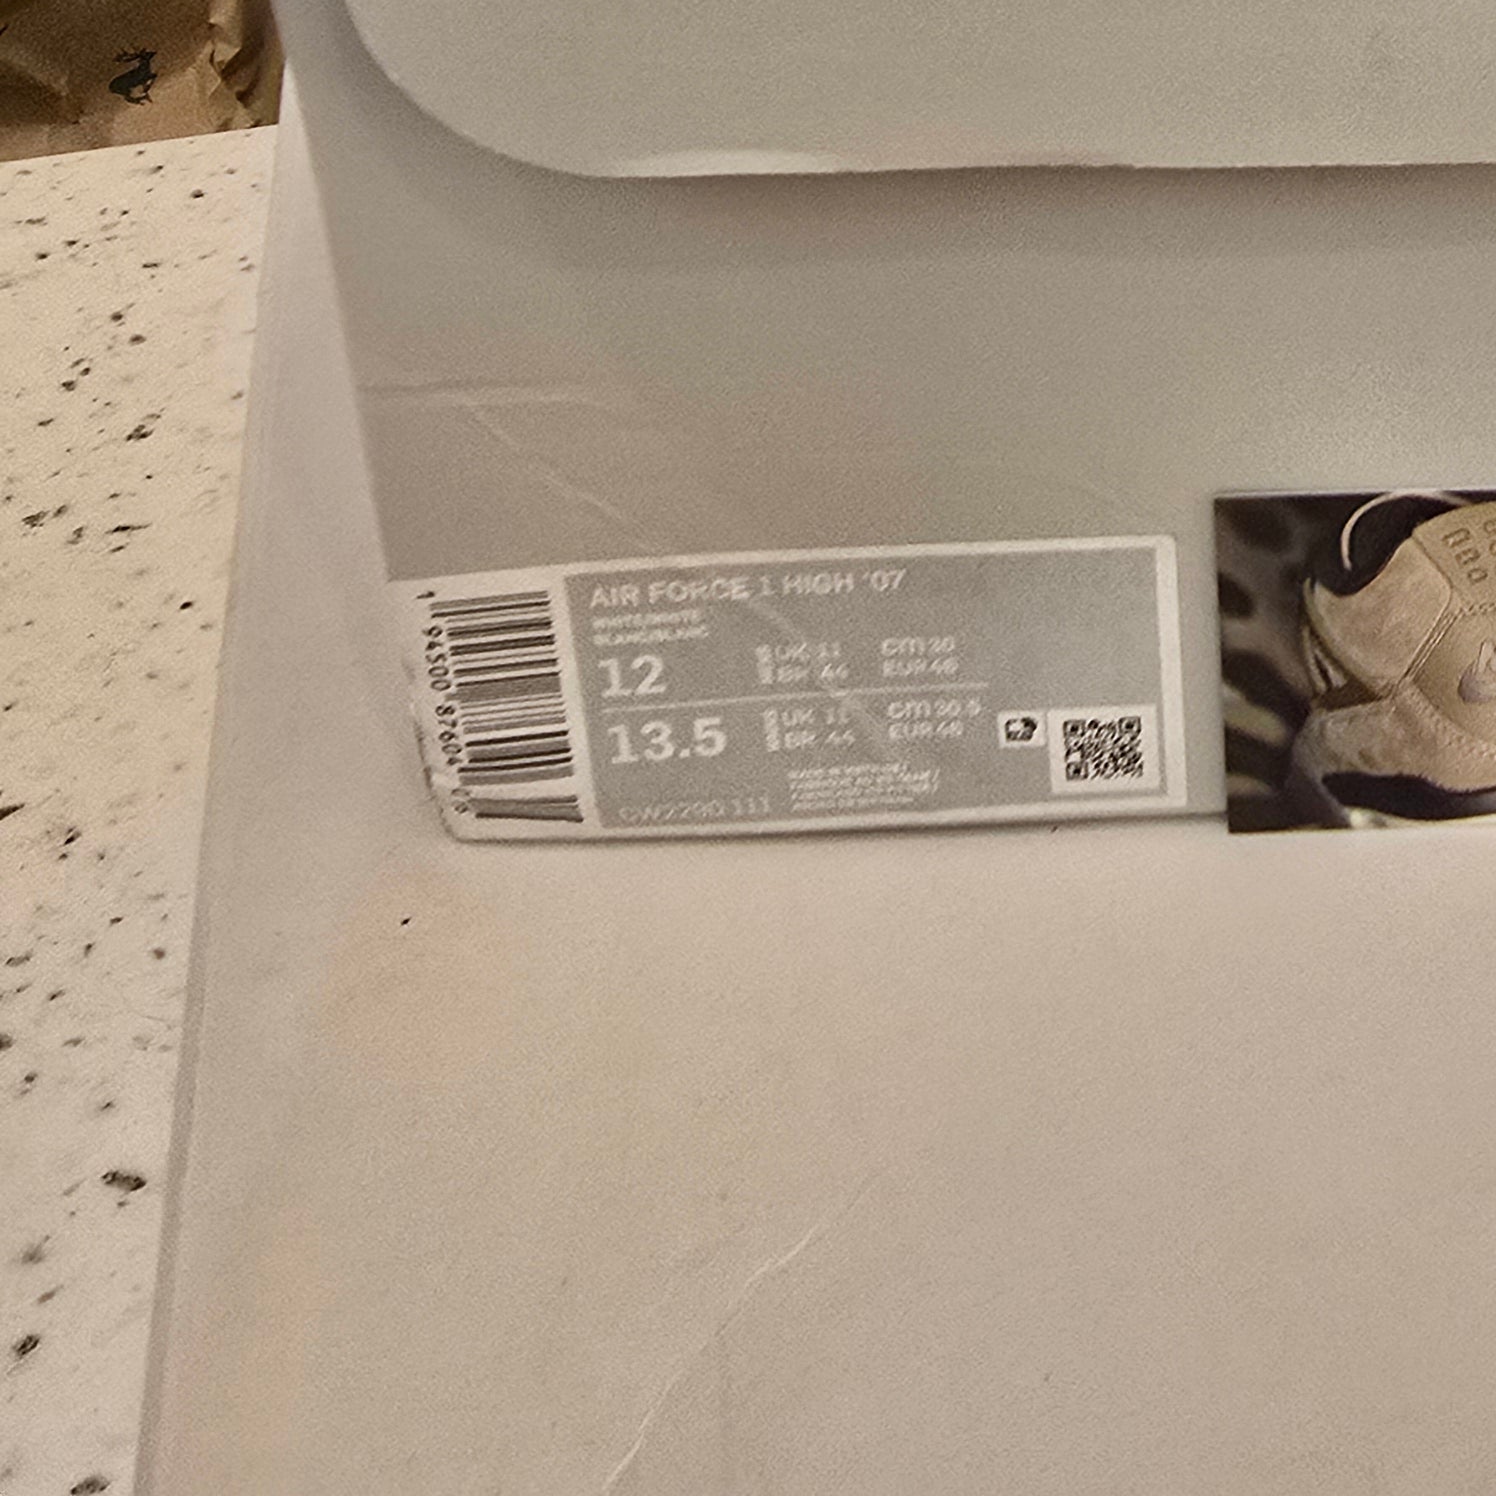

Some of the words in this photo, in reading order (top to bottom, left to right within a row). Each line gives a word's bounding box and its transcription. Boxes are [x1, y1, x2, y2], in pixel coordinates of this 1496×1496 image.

[590, 583, 640, 609] AIR
[648, 576, 750, 606] FORCE
[782, 571, 855, 595] HIGH
[600, 654, 667, 697] 12
[606, 716, 728, 765] 13.5
